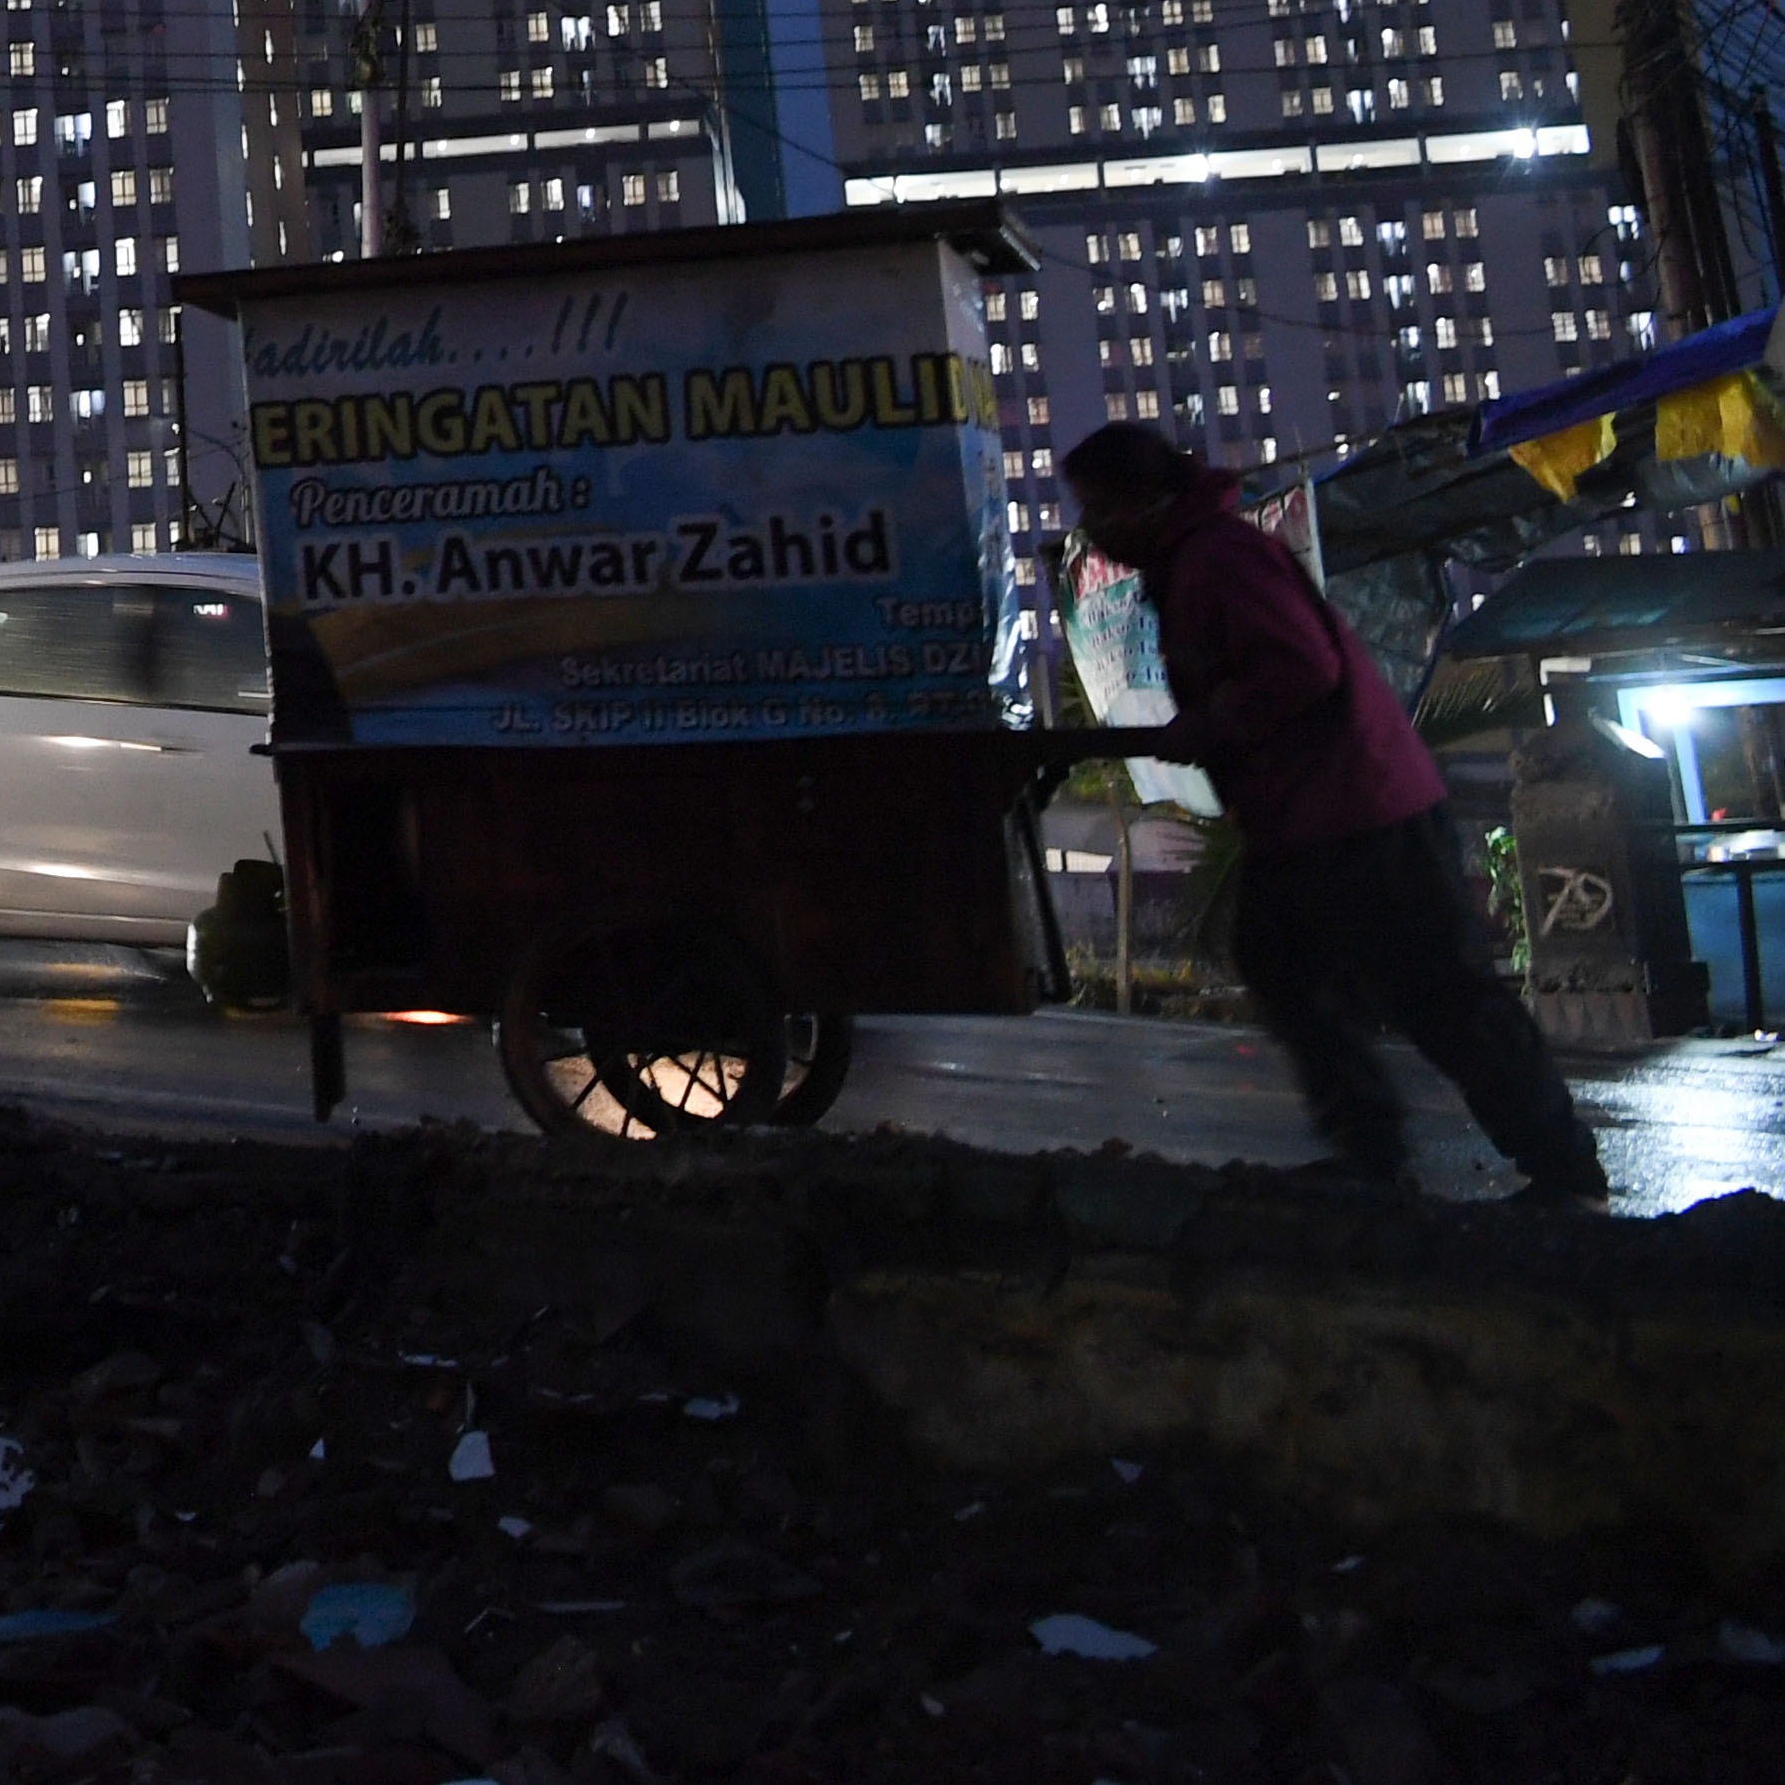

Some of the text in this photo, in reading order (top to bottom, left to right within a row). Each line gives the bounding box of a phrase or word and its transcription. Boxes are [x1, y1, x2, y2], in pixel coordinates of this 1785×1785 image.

[253, 371, 670, 467] ERINGATAN
[291, 465, 564, 527] Penceramah
[303, 512, 890, 600] KH. Anwar Zahid
[875, 595, 984, 632] Temp
[561, 640, 989, 688] Sekretariat MAJELIS DZI
[551, 700, 633, 732] SKIP
[675, 693, 750, 730] Blok
[761, 695, 788, 726] G
